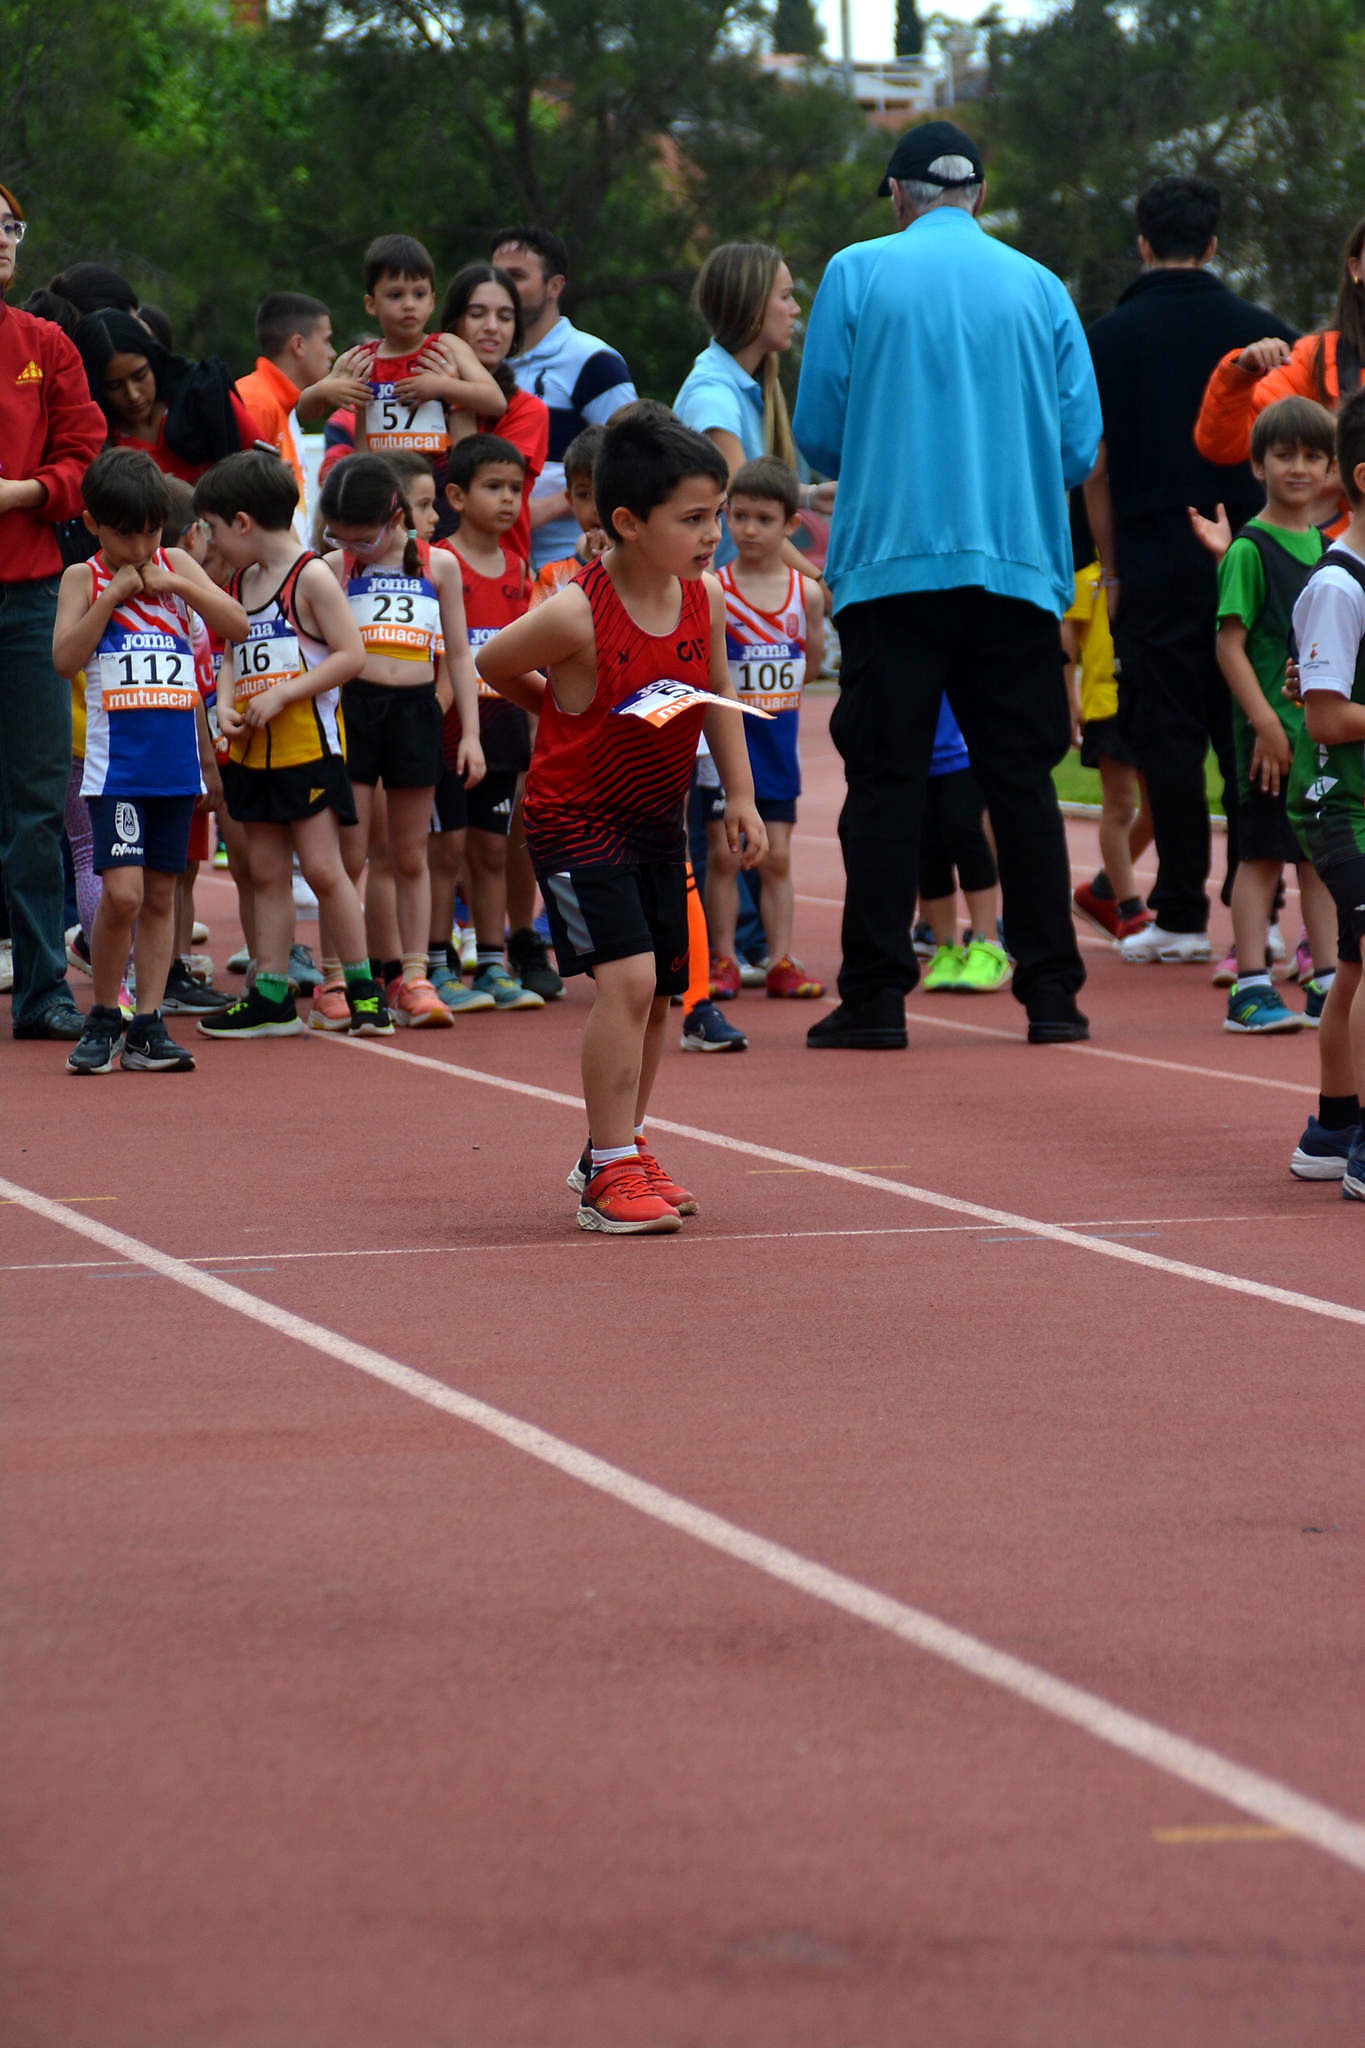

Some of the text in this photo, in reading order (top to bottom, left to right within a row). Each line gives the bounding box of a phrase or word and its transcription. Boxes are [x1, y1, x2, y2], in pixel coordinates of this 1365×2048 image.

[383, 402, 418, 430] 57
[370, 434, 440, 449] mutuacat
[373, 594, 414, 623] 23
[118, 653, 184, 686] 112
[239, 641, 271, 676] 16
[739, 662, 794, 691] 106
[108, 689, 193, 707] mutuacat
